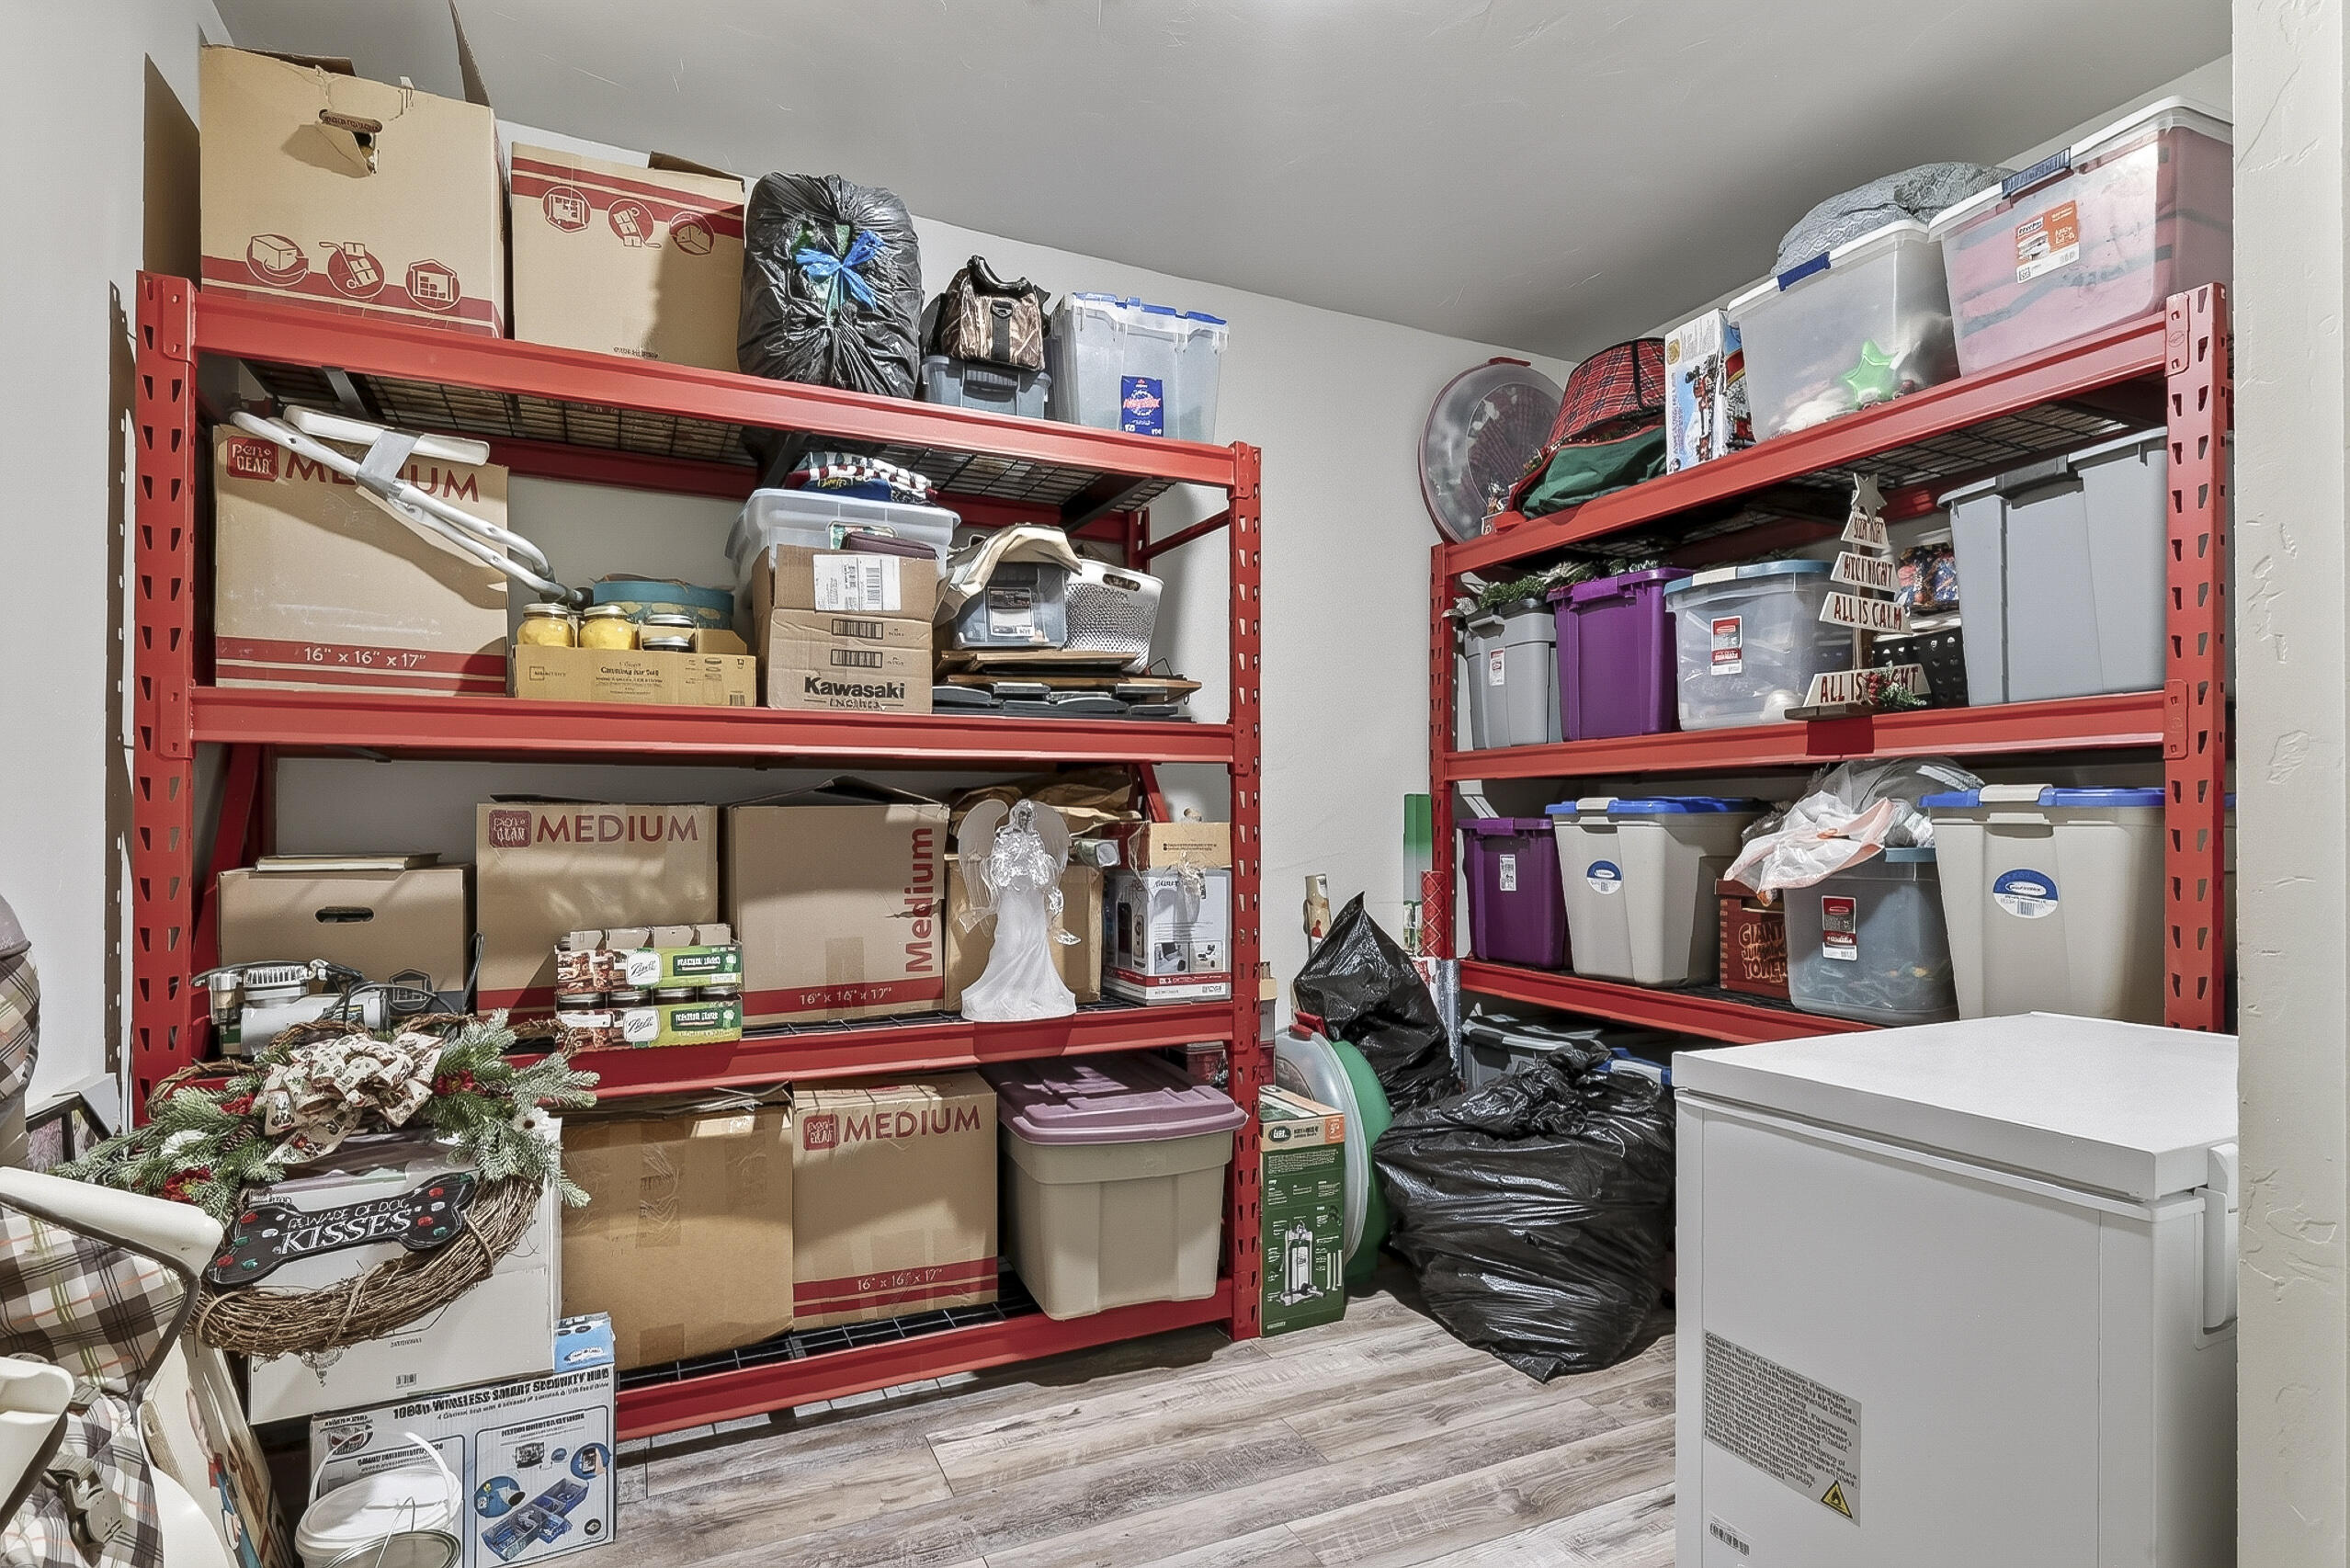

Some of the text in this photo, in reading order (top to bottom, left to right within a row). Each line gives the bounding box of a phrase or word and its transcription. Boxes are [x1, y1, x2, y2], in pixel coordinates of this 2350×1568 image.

[286, 448, 479, 503] MUM
[1833, 596, 1902, 631] ALL IS CALM
[304, 646, 426, 667] 16" x 16" x 17"
[804, 676, 905, 699] Kawasaki
[1821, 676, 1845, 703] ALL
[1851, 673, 1864, 701] IS
[536, 814, 698, 843] MEDIUM
[904, 828, 934, 972] Medium
[844, 1105, 981, 1142] MEDIUM
[281, 1210, 413, 1255] KISSES
[433, 1392, 491, 1412] WIRELESS
